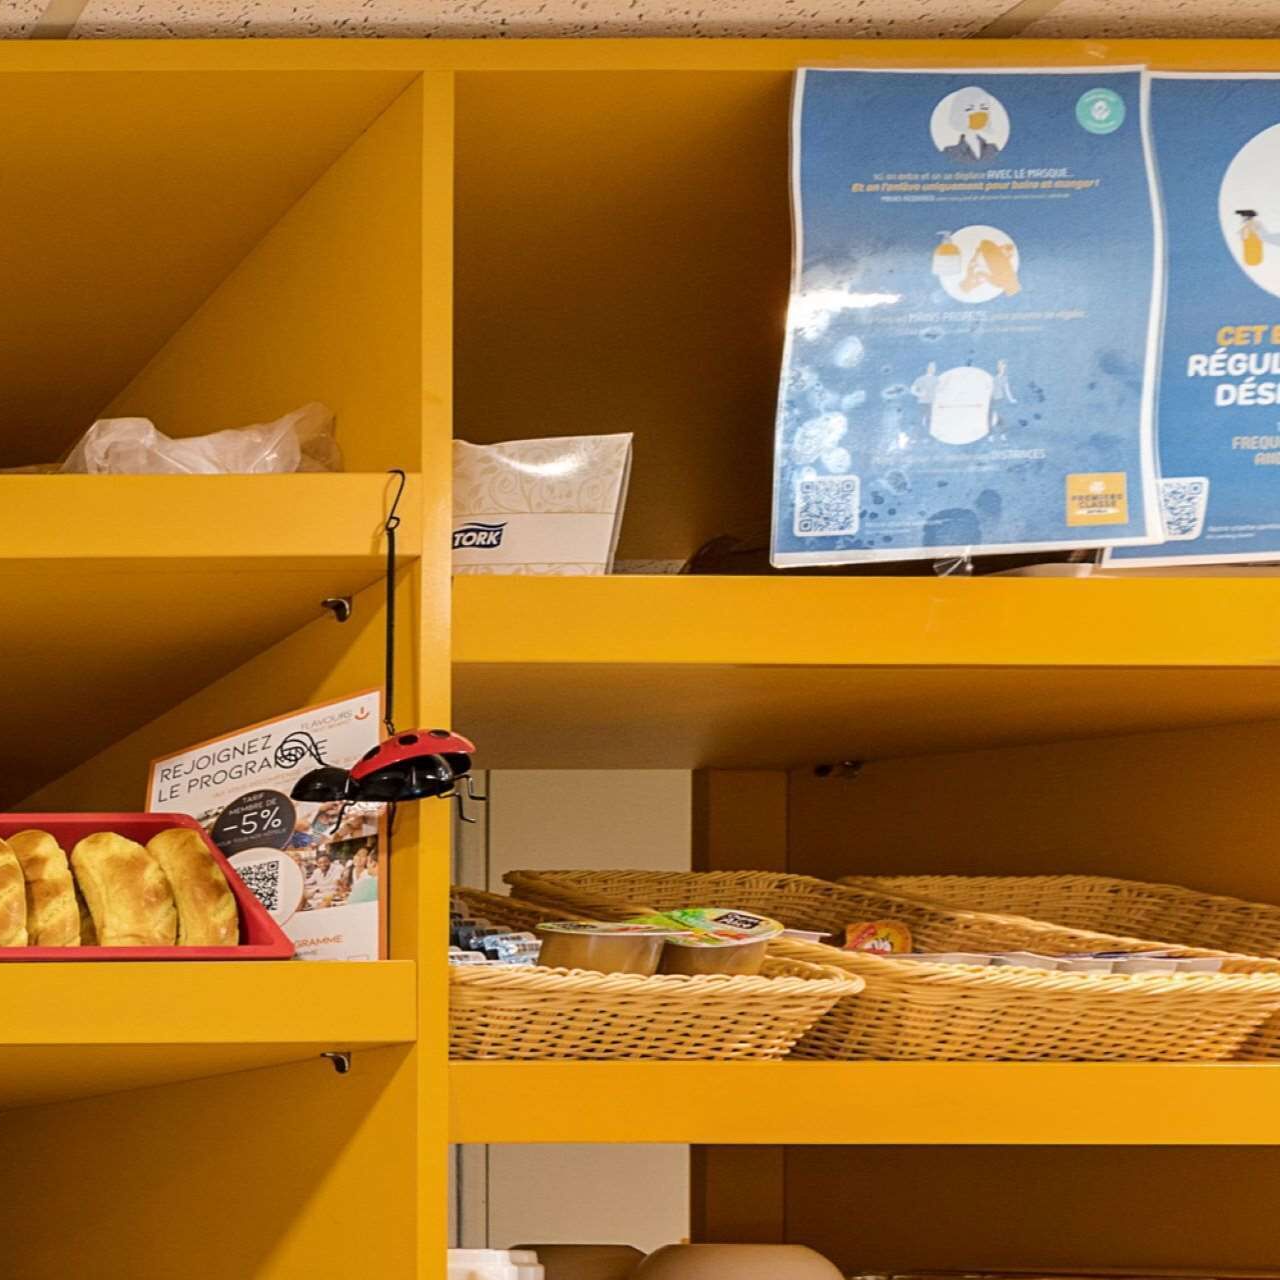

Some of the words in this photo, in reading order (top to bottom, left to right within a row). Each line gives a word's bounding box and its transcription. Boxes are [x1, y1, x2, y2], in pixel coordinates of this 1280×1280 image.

[986, 169, 1012, 180] AVEC
[1014, 169, 1026, 179] LE
[1216, 325, 1268, 347] CET
[454, 531, 500, 547] TORK
[159, 734, 272, 782] REJOIGNEZ
[158, 783, 180, 803] LE
